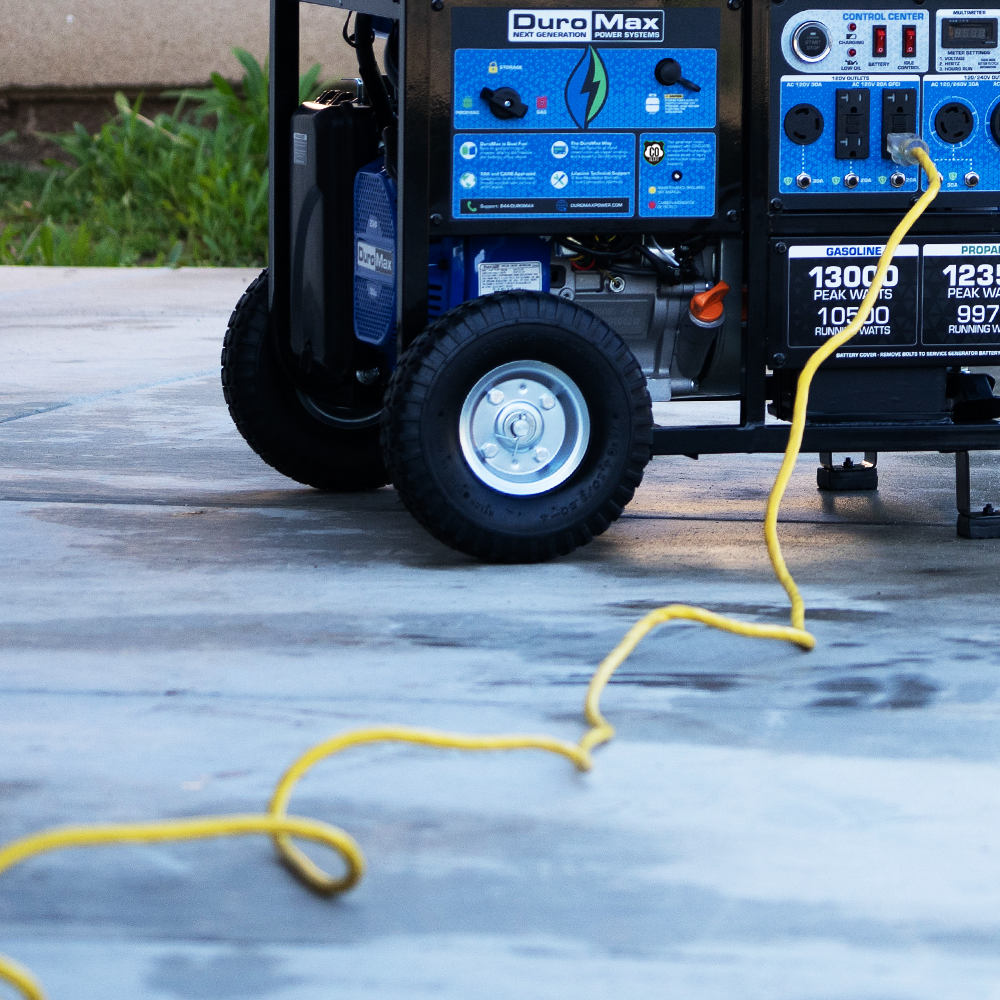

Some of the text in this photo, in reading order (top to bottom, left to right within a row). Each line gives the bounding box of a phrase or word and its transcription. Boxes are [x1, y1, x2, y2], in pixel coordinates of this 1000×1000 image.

[842, 13, 924, 21] CONTROL CENTER
[649, 147, 659, 157] CO
[826, 246, 882, 256] GASOLINE
[808, 265, 899, 288] 13000
[813, 288, 893, 301] PEAK WATS
[947, 288, 980, 299] PEAK
[814, 325, 891, 336] RUNN WATTS
[948, 325, 991, 335] RUNNING
